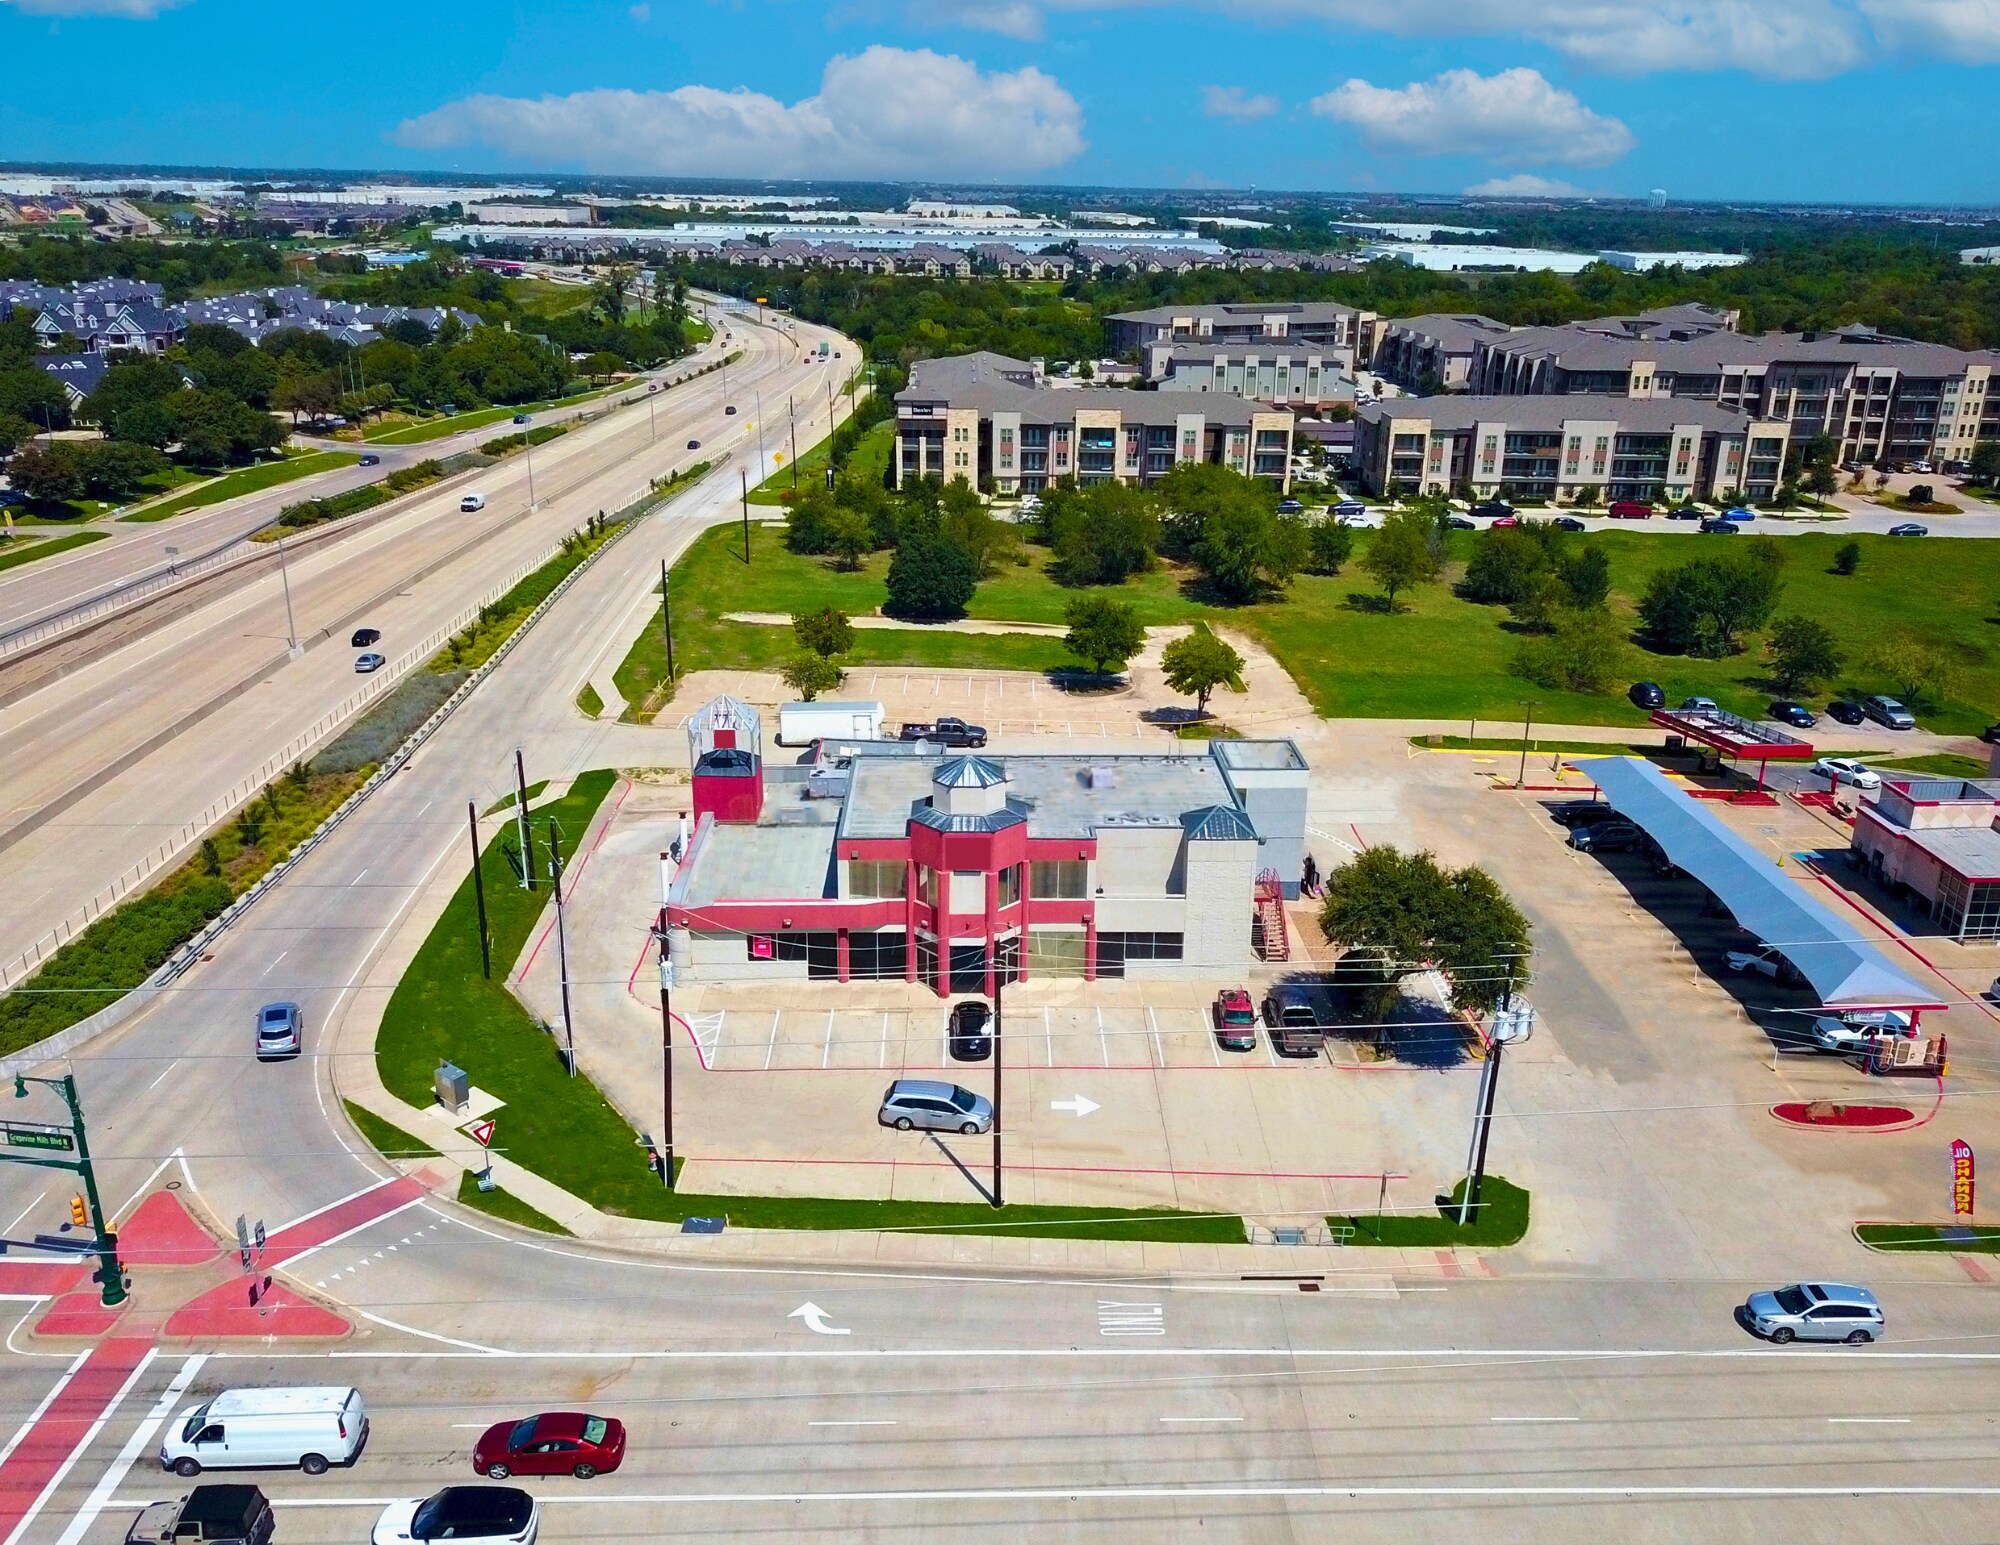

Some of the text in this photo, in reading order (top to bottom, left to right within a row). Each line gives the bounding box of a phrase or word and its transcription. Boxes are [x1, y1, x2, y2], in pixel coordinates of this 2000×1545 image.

[10, 1134, 36, 1143] Grapevine
[36, 1136, 49, 1144] Mills
[49, 1137, 62, 1145] Blvd
[1097, 1300, 1166, 1336] ONLY
